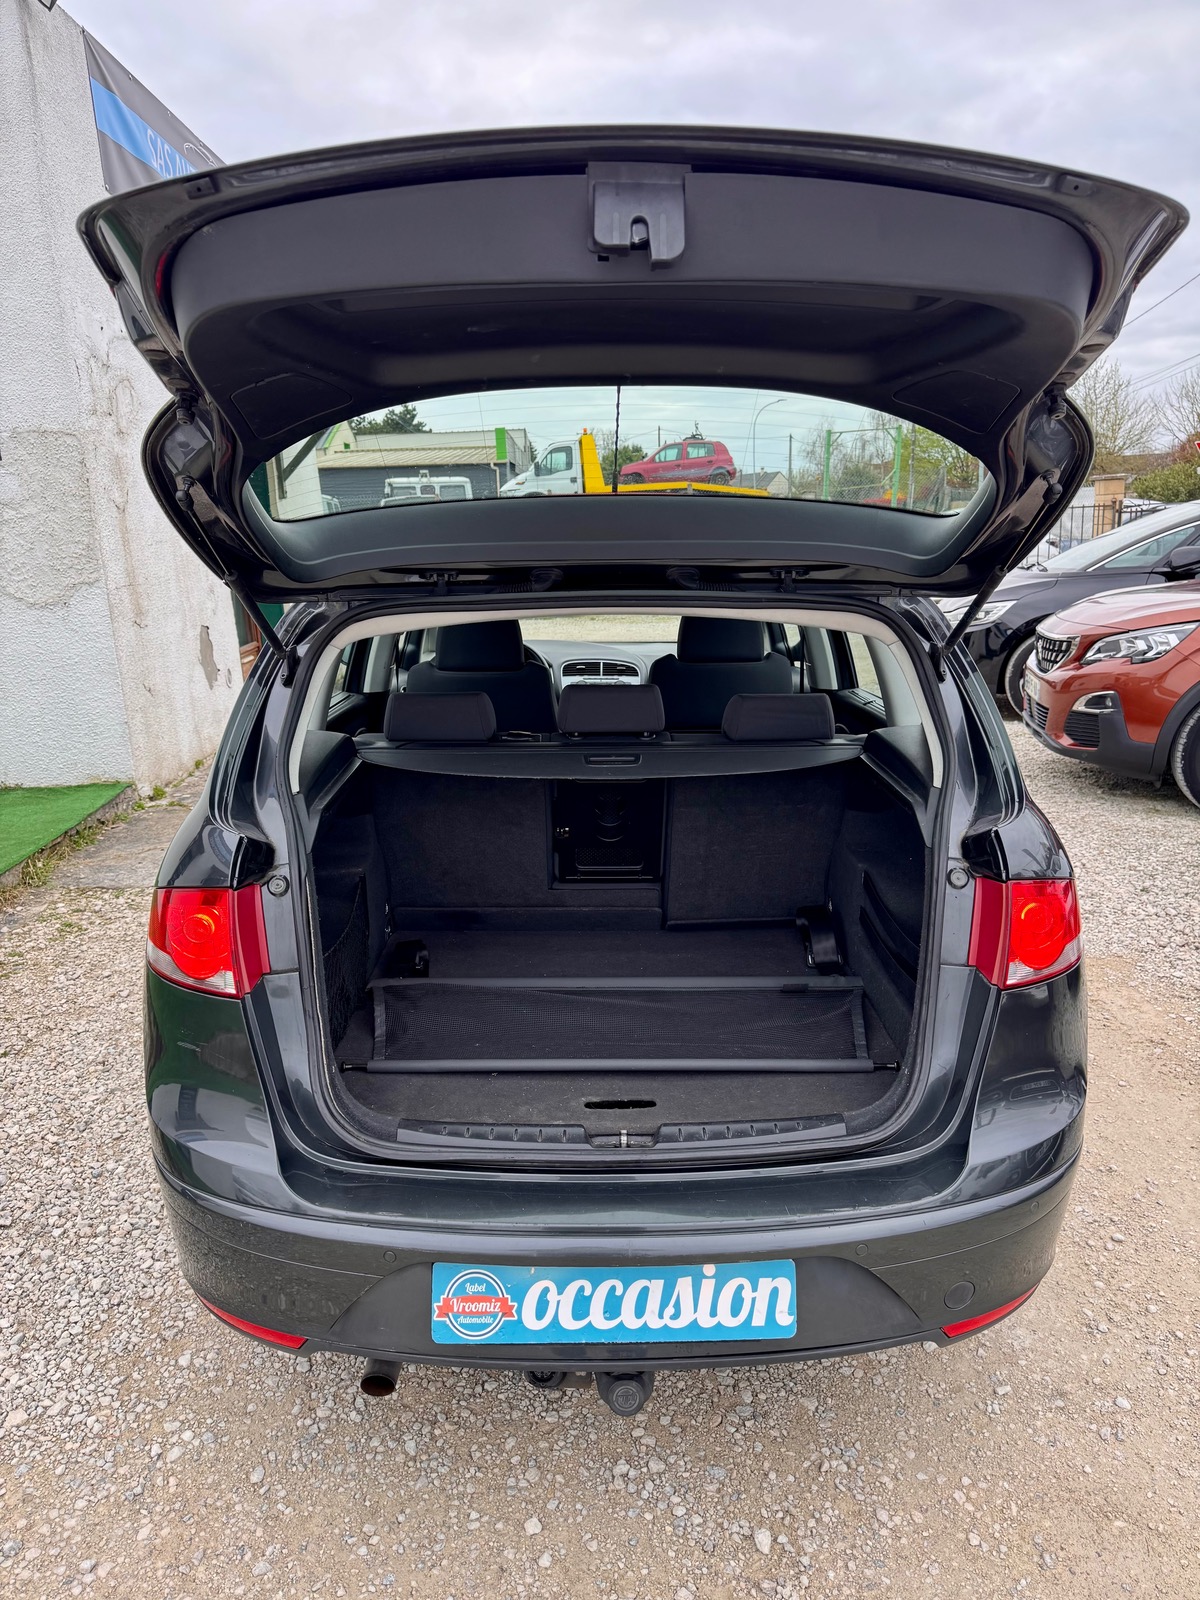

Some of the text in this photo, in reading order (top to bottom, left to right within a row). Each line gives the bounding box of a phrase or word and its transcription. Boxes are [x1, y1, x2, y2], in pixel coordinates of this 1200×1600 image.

[147, 128, 198, 180] SAS AU
[465, 1282, 487, 1295] Label
[521, 1263, 795, 1331] occasion
[449, 1298, 501, 1312] Vroomiz
[457, 1315, 494, 1325] Automobile
